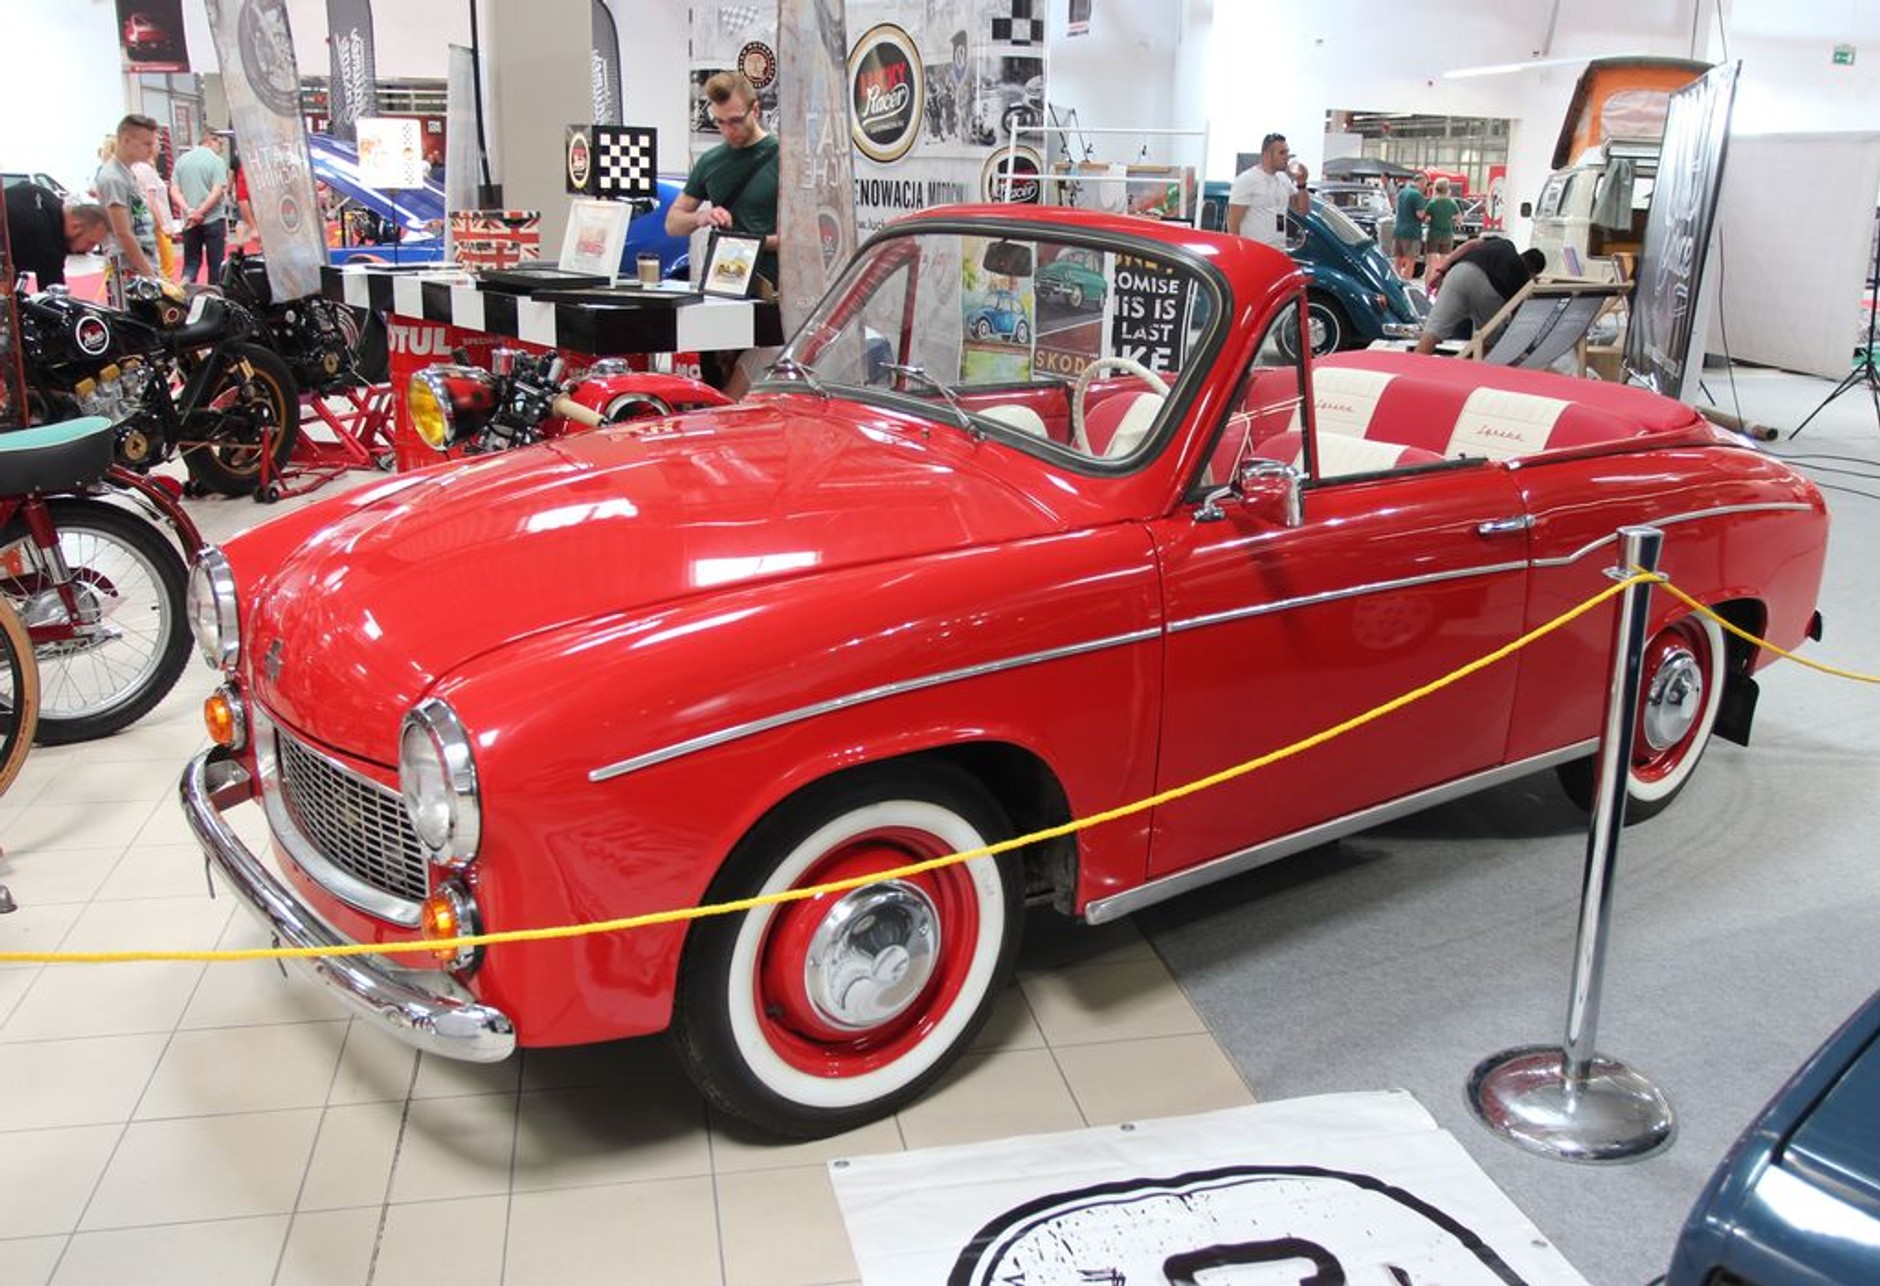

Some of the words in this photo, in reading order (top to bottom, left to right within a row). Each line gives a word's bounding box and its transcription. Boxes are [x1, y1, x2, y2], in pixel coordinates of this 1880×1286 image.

[862, 82, 909, 121] Racer
[855, 178, 924, 210] NOWACJA
[1116, 272, 1181, 294] OMISE
[388, 324, 452, 356] OTUL
[1121, 322, 1174, 342] LAST
[1118, 345, 1173, 375] KE
